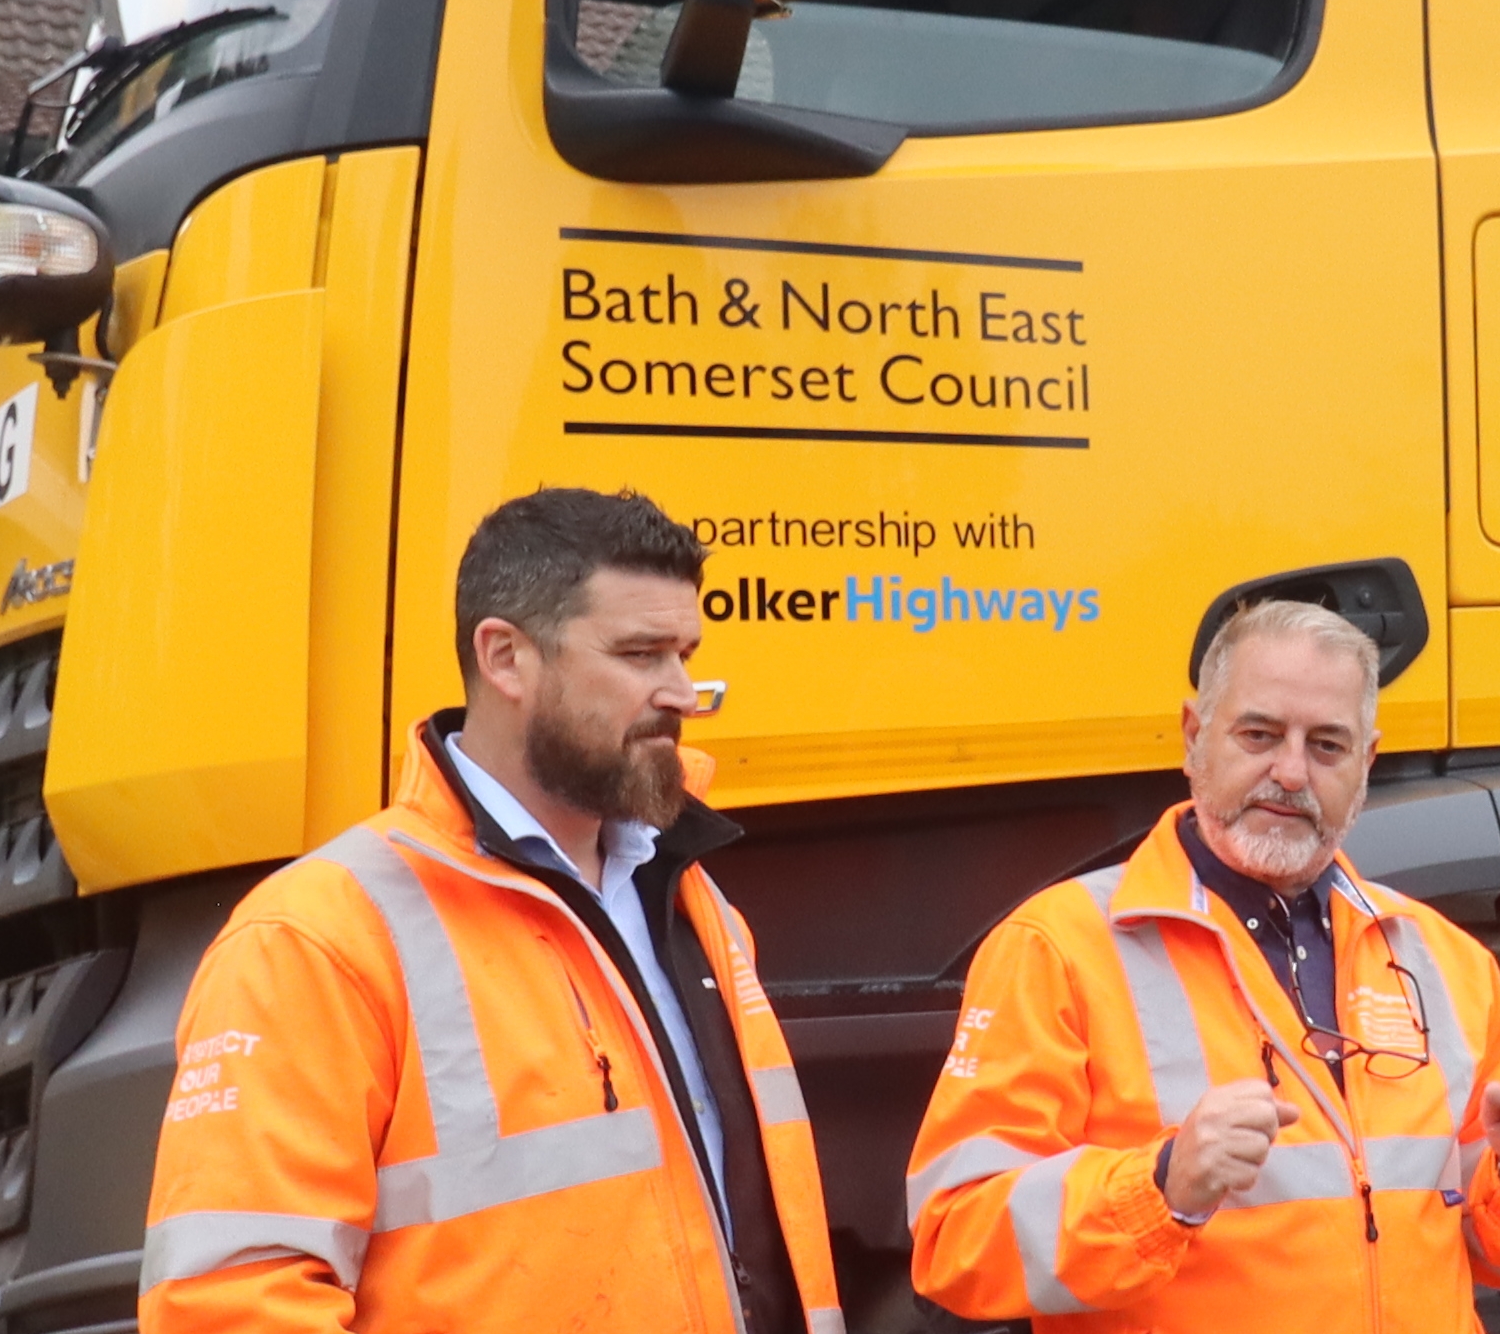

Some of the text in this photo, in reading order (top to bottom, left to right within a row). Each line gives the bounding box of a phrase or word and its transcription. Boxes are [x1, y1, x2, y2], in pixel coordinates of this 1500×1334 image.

[562, 267, 1088, 346] Bath & North East
[562, 339, 1090, 412] Somerset Council
[692, 510, 1036, 558] partnership with
[702, 575, 1101, 633] olkerHighways
